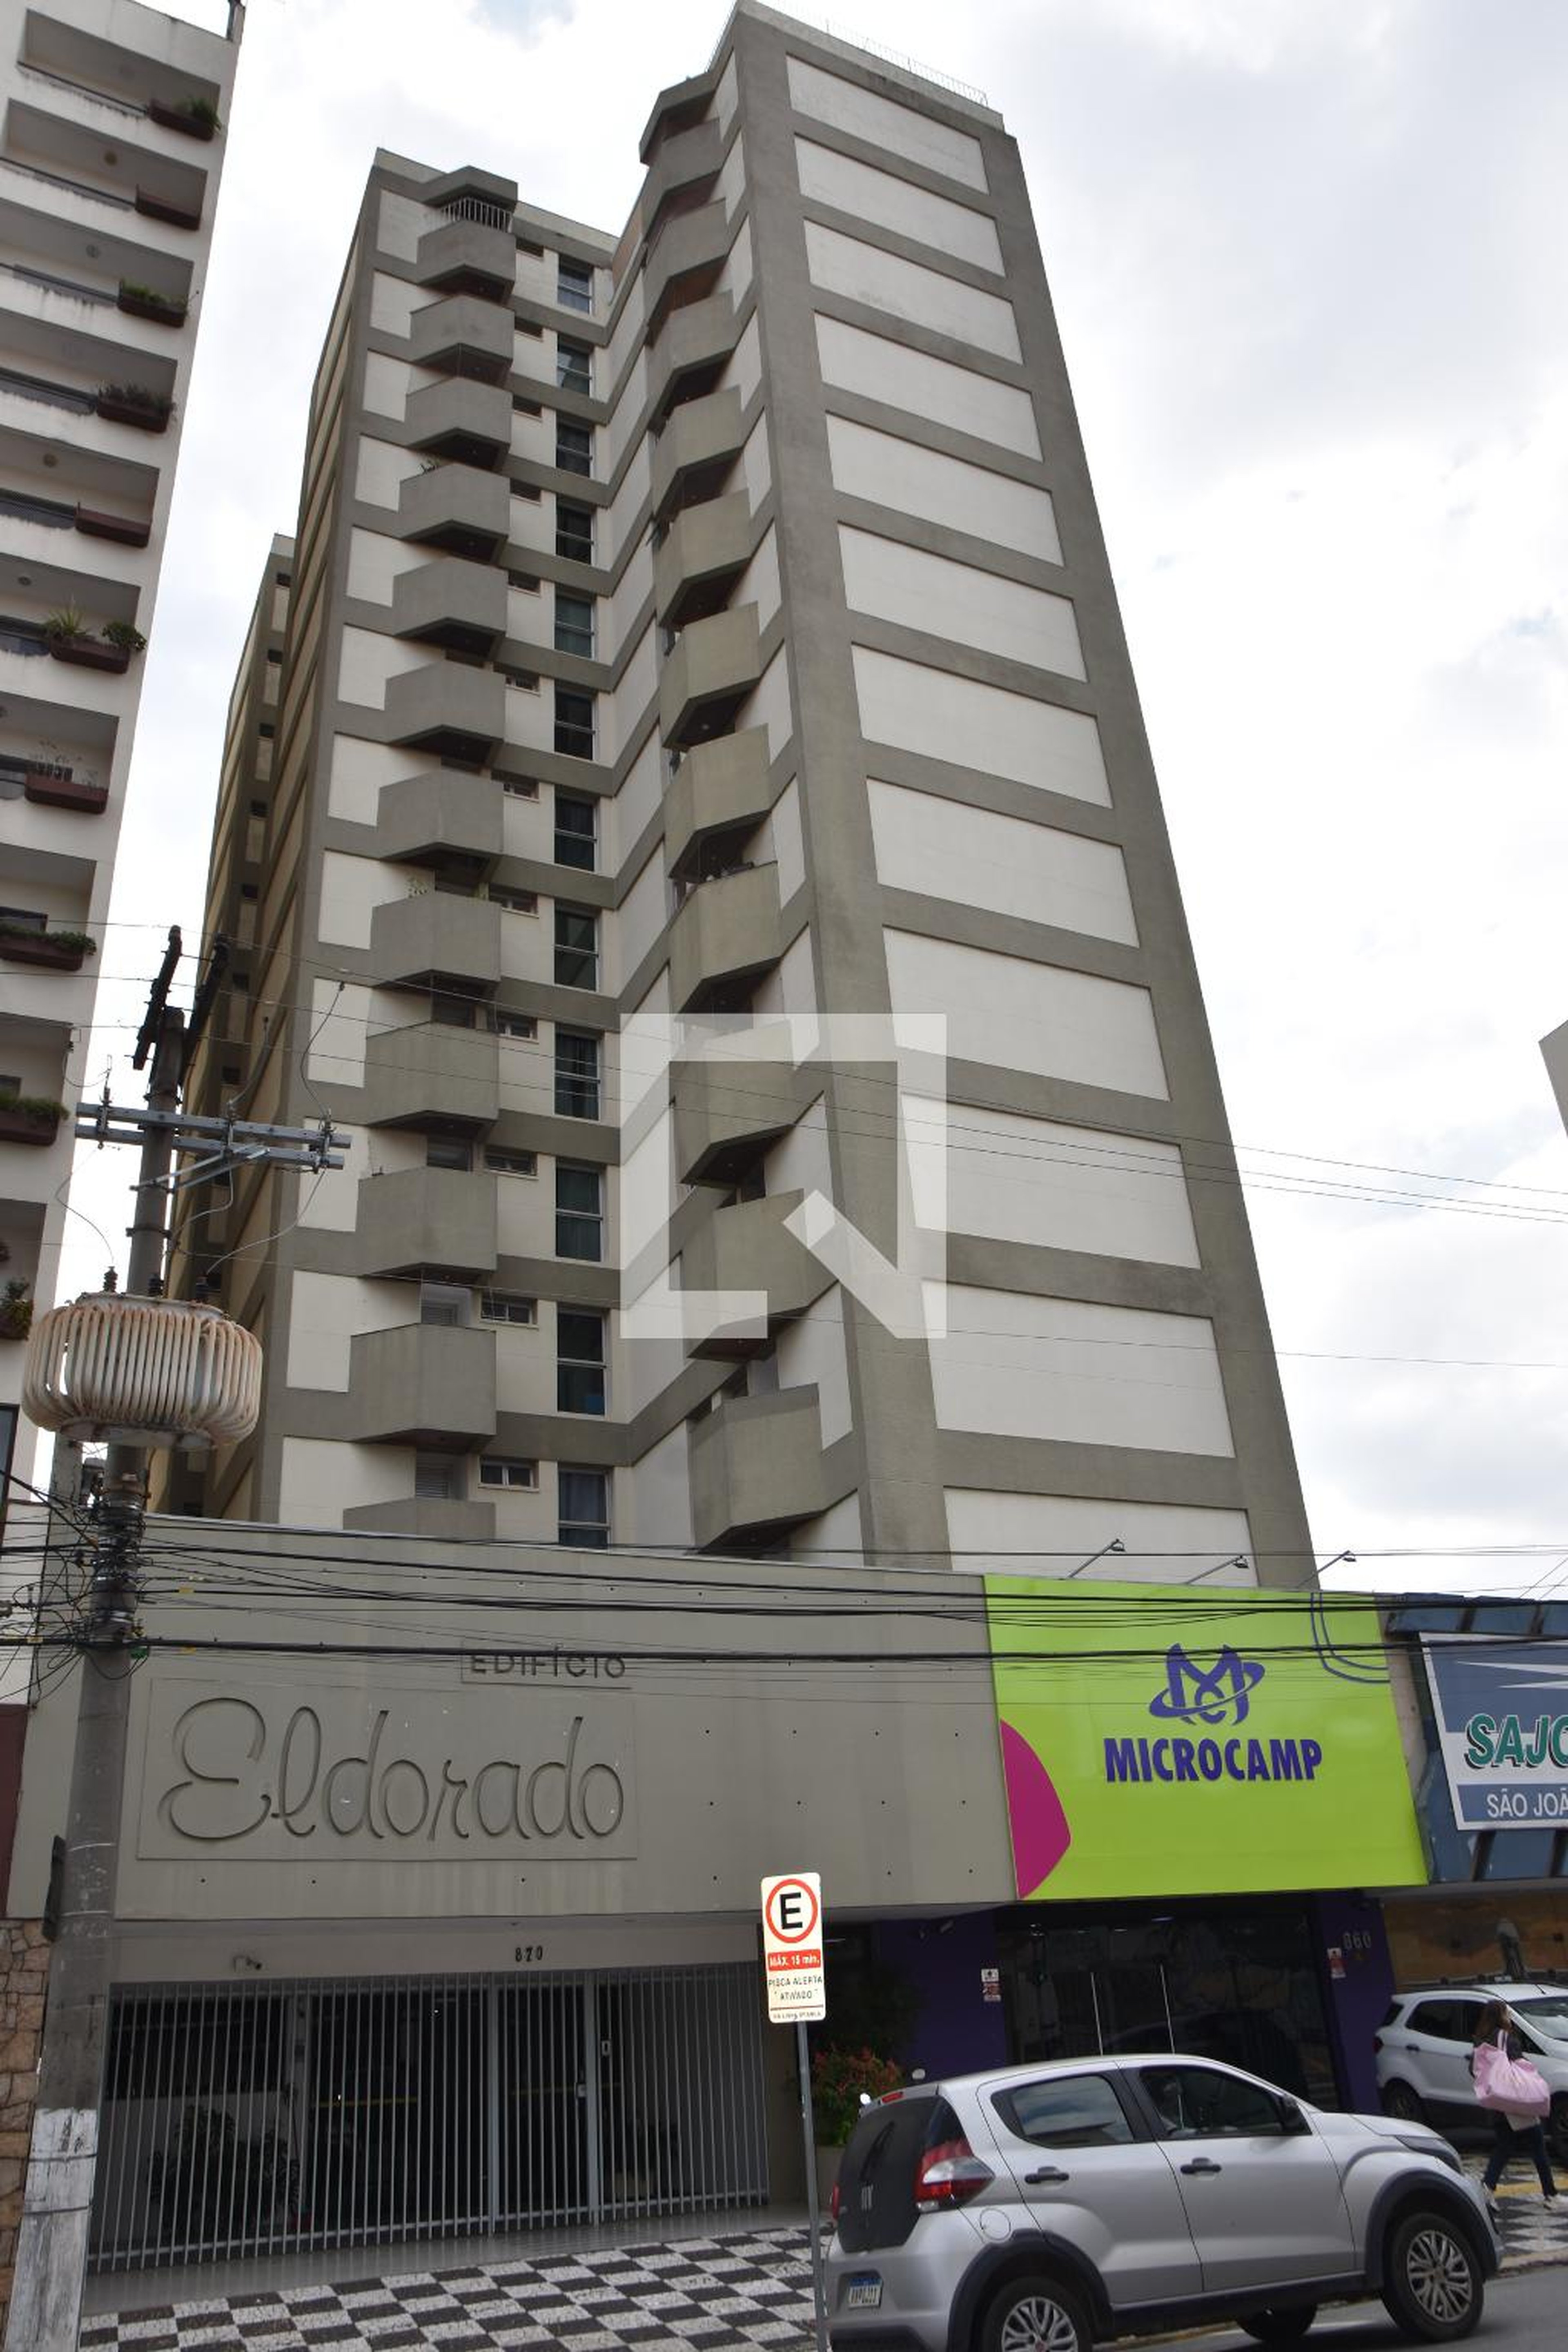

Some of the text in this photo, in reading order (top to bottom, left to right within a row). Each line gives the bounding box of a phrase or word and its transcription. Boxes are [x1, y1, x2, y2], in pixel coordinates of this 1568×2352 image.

[470, 1646, 625, 1678] EDIFÍCIO
[159, 1697, 624, 1841] Eldorado
[1104, 1738, 1322, 1782] MICROCAMP
[1487, 1788, 1528, 1817] SÃO
[780, 1892, 803, 1930] E
[769, 1976, 822, 1987] PISCA ALERTA
